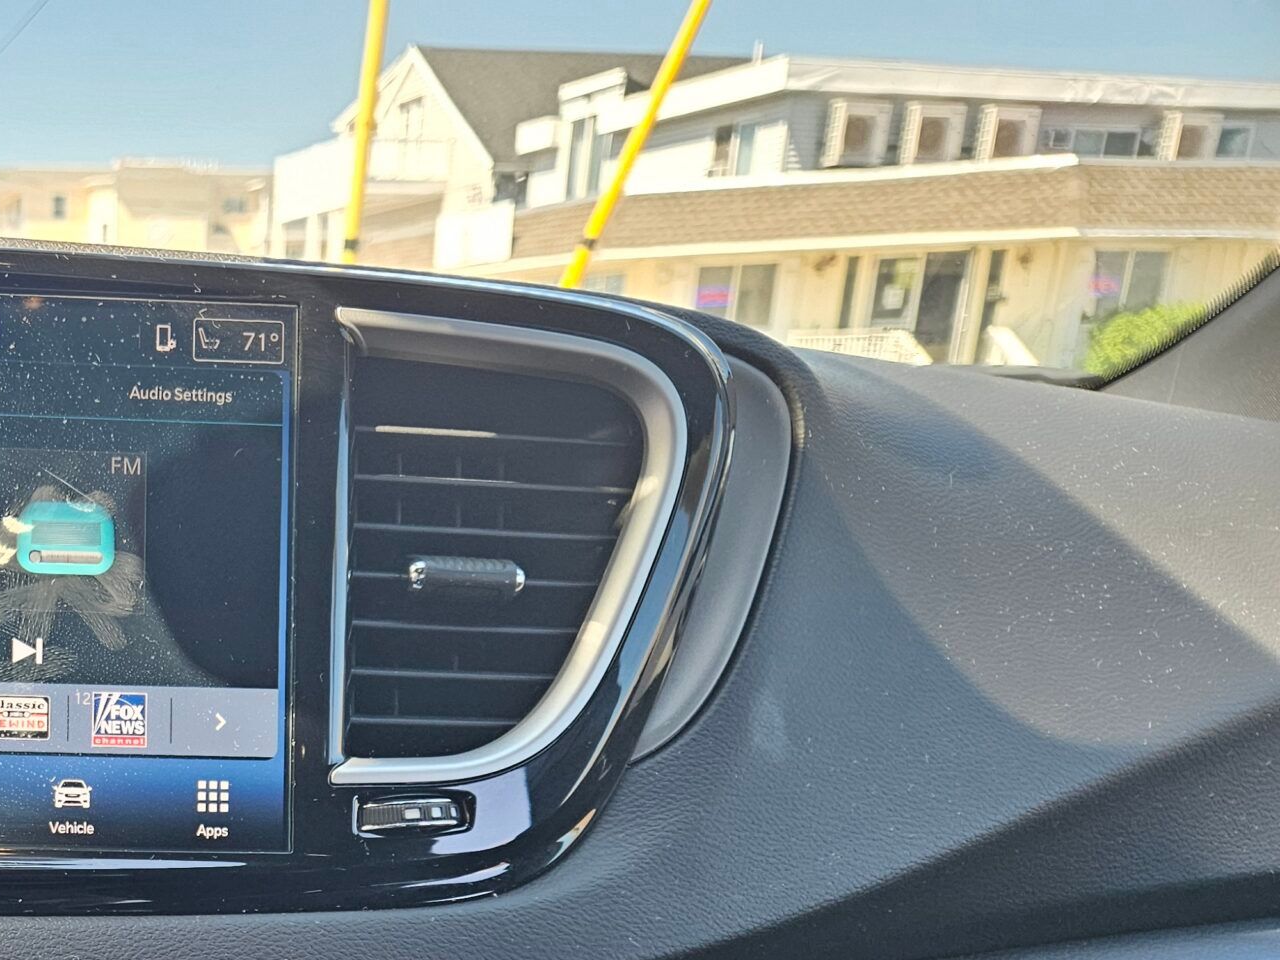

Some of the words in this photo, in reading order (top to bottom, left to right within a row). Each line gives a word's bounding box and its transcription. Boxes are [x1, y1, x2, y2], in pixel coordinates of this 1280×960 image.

[242, 332, 279, 352] 71°
[130, 386, 171, 402] Audio
[174, 387, 232, 405] Settings
[111, 456, 142, 476] FM
[75, 692, 91, 705] 12
[111, 704, 144, 720] FOX
[99, 720, 145, 735] NEWS
[95, 737, 144, 745] channel
[49, 821, 94, 836] Vehicle
[196, 824, 229, 840] Apps
